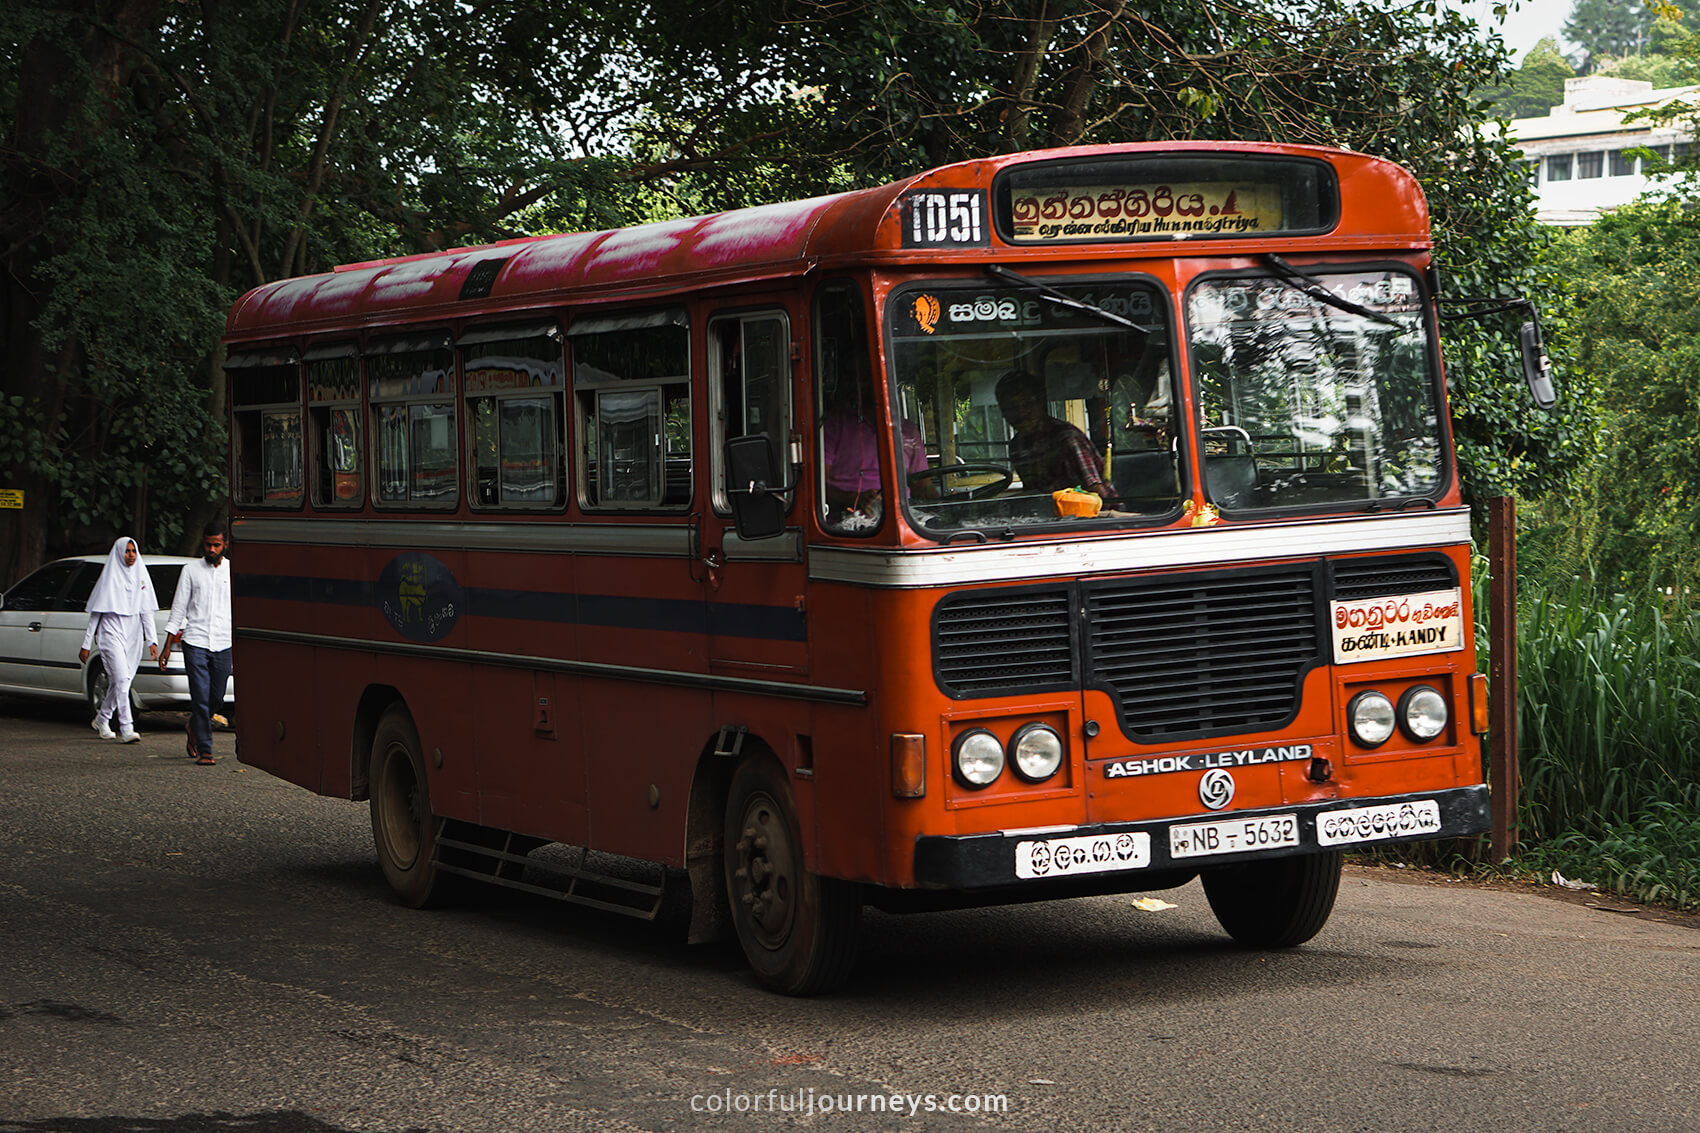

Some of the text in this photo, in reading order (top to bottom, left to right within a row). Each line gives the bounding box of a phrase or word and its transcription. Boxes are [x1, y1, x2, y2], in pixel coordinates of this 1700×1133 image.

[908, 193, 981, 242] TD51
[1397, 626, 1447, 646] KANDY
[1108, 745, 1312, 777] ASHOK LEYLAND
